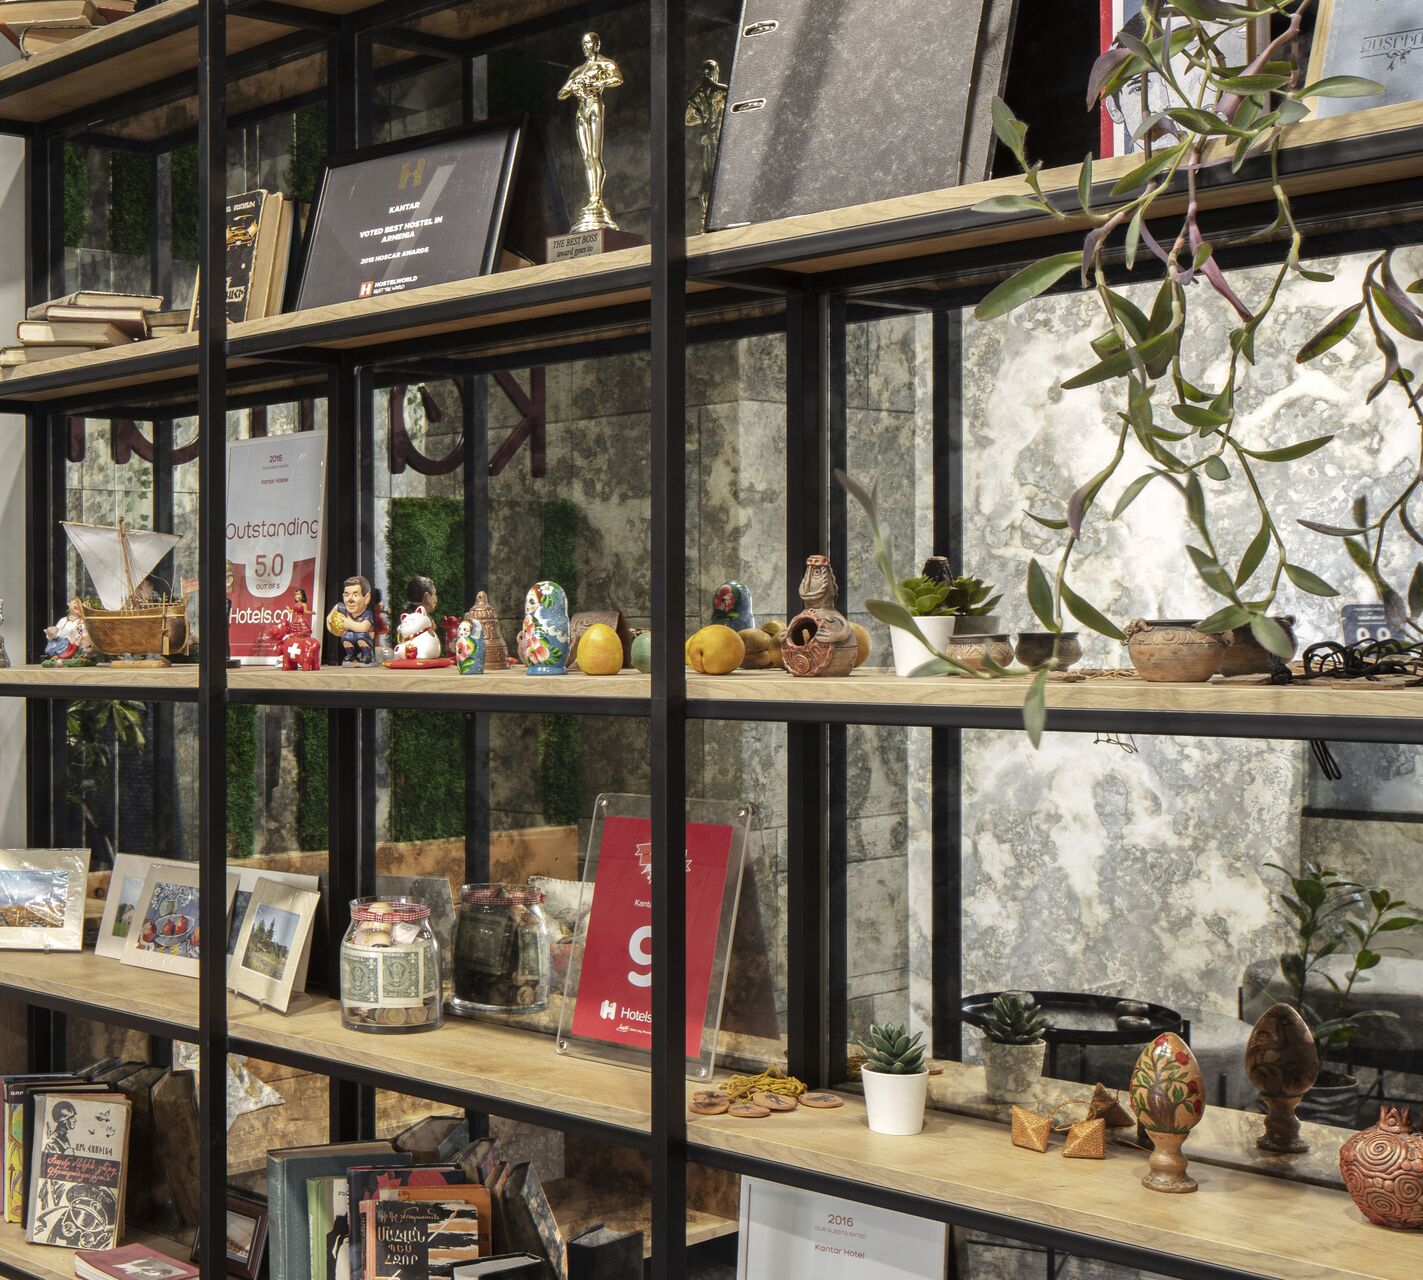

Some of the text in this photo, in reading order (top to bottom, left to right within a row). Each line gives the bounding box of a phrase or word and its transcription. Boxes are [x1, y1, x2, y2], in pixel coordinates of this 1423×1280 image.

[388, 201, 420, 214] KANTAR
[360, 216, 443, 238] VOTED BEST HOSTEL IN
[381, 231, 415, 243] ARMENIA
[553, 233, 598, 249] THE BEST BOSS
[375, 252, 401, 263] HOSCAR
[401, 247, 429, 258] AWARDS
[557, 247, 574, 257] award
[574, 248, 586, 257] goes
[374, 275, 418, 288] HOSTELWORLD
[226, 517, 319, 539] Outstanding
[255, 553, 284, 578] 5.0
[828, 1214, 854, 1228] 2016
[377, 1225, 426, 1244] ՄԱՀՎԱՆ
[388, 1244, 412, 1255] ՊԵՍ
[814, 1243, 865, 1259] Kantar Hotel
[384, 1255, 419, 1266] ՀԶՈՐ
